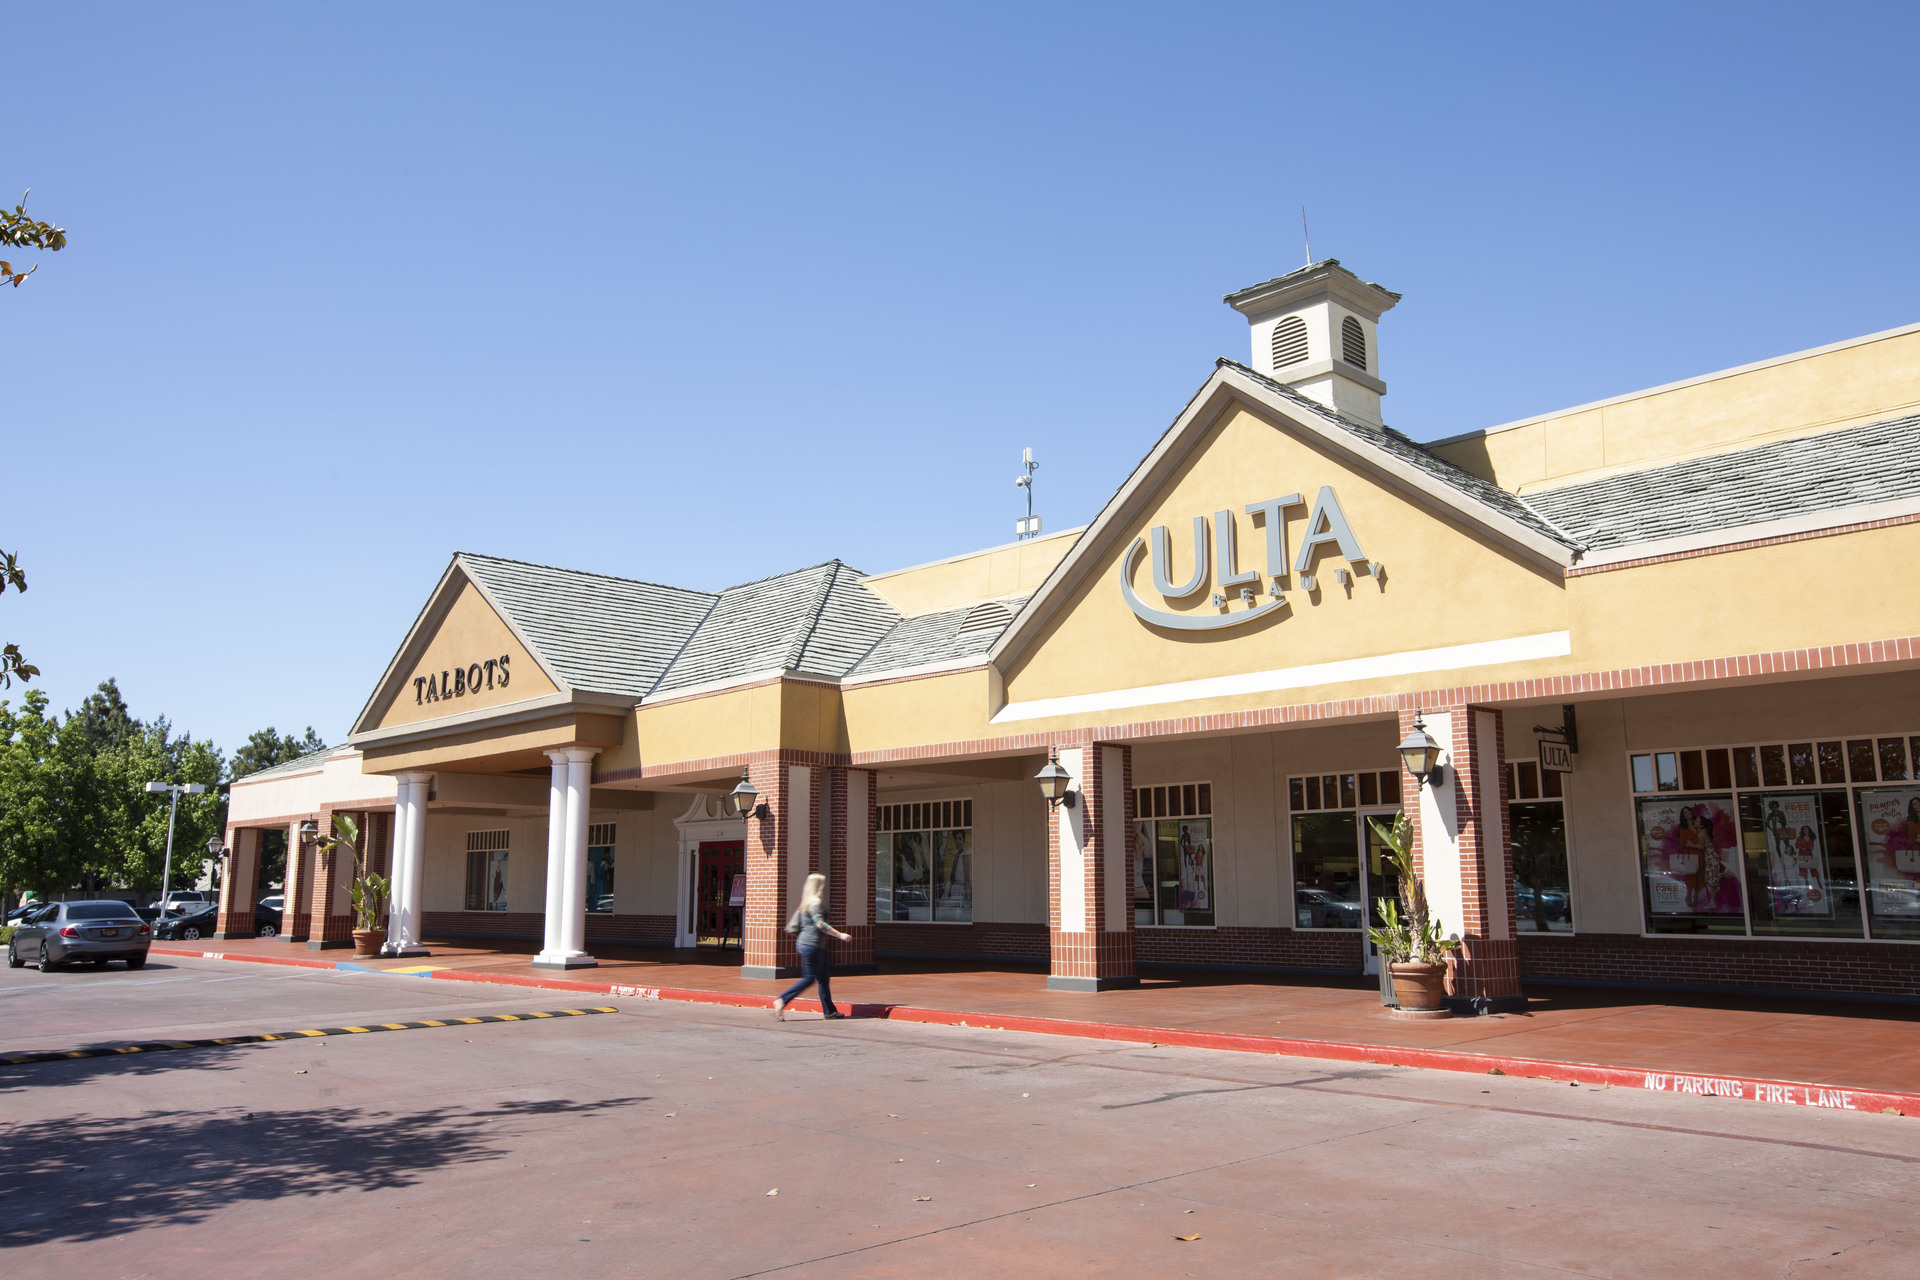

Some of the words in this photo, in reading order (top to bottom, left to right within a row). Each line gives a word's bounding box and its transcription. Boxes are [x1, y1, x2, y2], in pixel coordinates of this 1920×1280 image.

[1151, 485, 1368, 597] ULTA
[1212, 562, 1385, 608] BEAUTY
[413, 654, 510, 702] TALBOTS
[1543, 746, 1570, 768] ULTA
[1784, 803, 1810, 811] FREE
[1657, 892, 1680, 900] TOTE
[1644, 1072, 1666, 1090] NO
[1673, 1075, 1743, 1097] PARKING
[1755, 1083, 1797, 1104] FIRE
[1805, 1087, 1856, 1110] LANE
